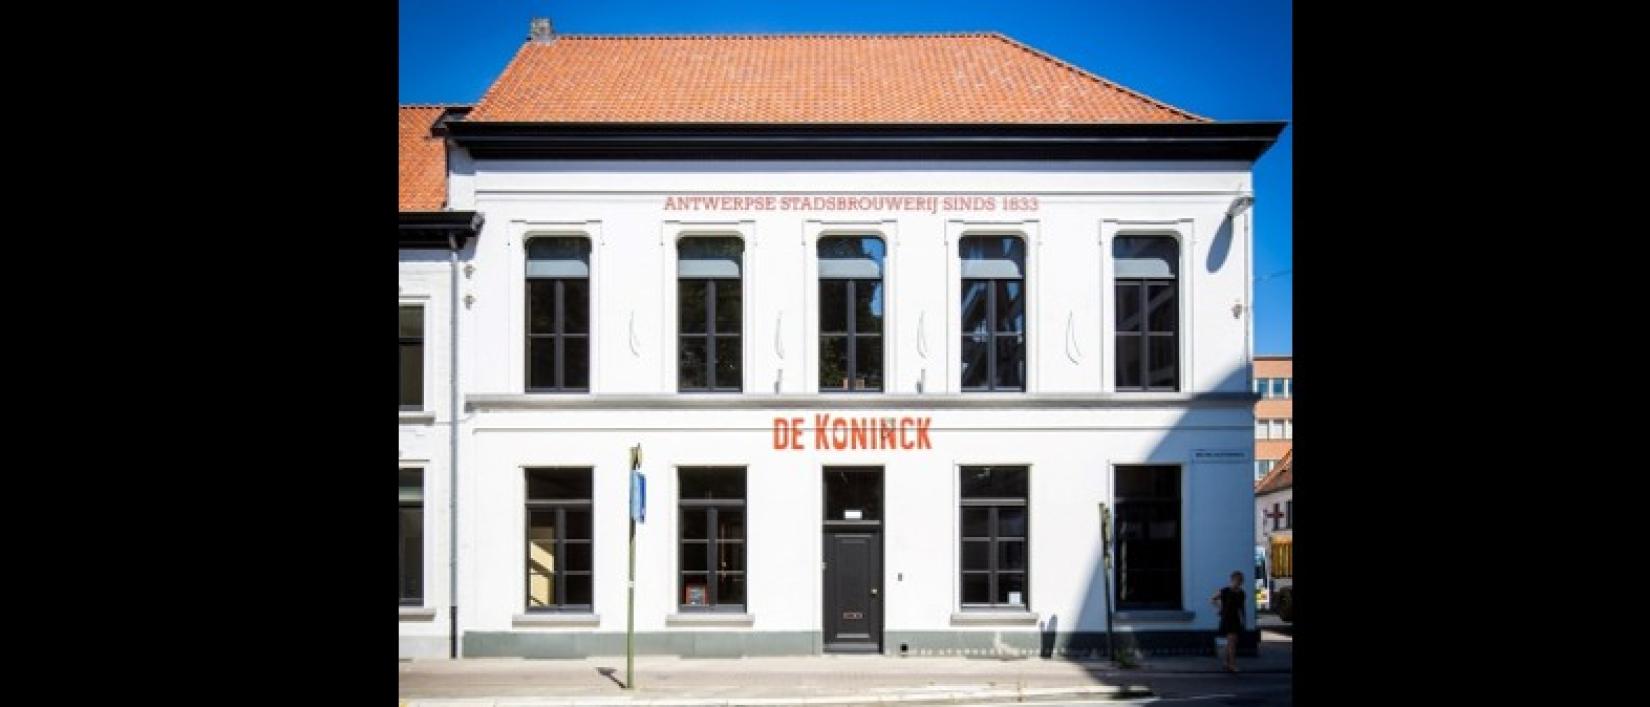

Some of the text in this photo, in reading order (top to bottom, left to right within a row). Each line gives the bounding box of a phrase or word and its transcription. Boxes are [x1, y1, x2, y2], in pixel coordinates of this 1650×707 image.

[664, 196, 1040, 214] ANTWERPSE STADSBROUWERIJ SINDS 1833
[773, 413, 932, 450] DE KONINCK
